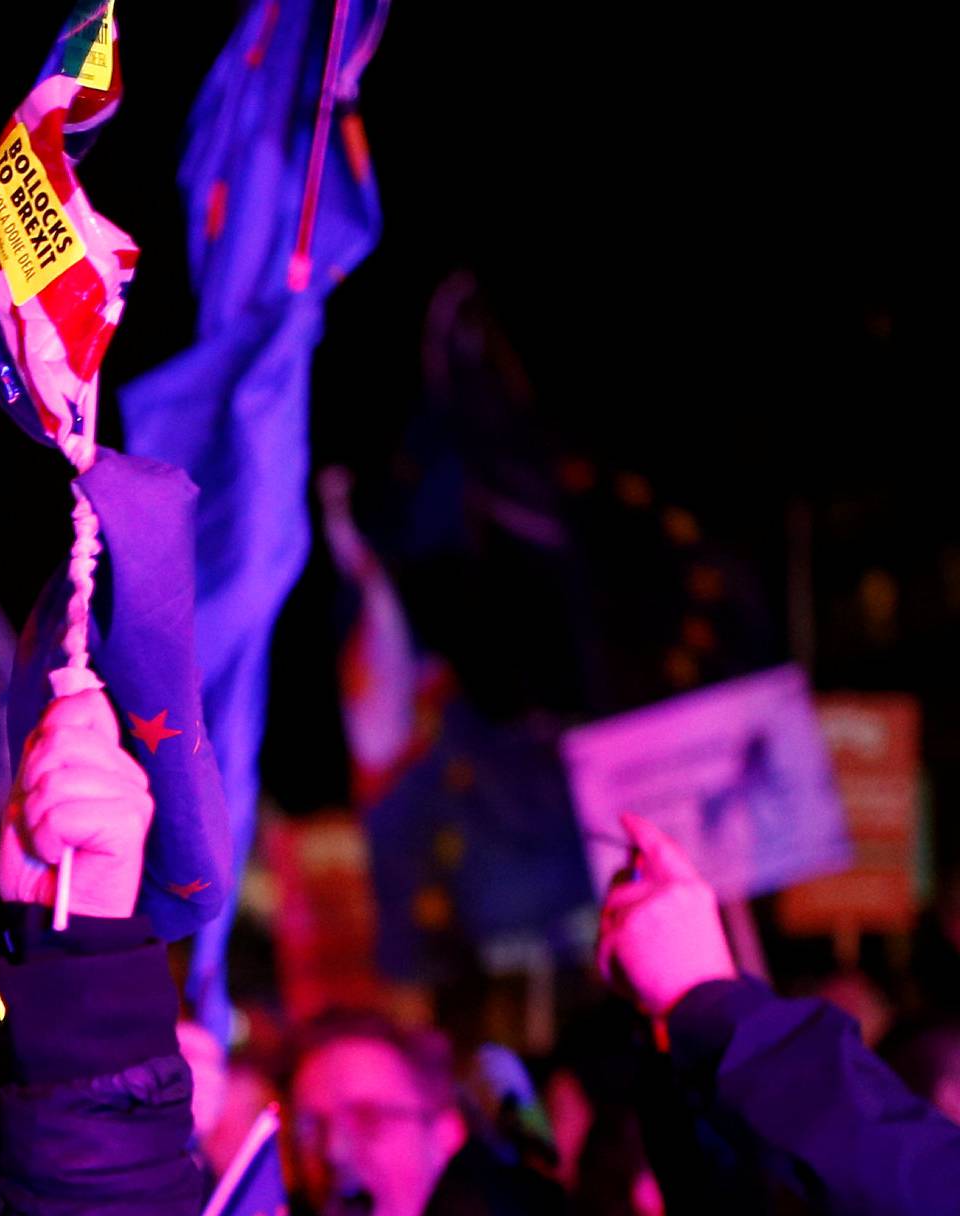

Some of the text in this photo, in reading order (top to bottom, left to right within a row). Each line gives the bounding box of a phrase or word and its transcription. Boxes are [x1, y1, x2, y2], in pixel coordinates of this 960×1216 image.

[9, 137, 73, 253] BOLLOCKS
[10, 186, 56, 269] BREXIT
[4, 223, 25, 254] DONE
[18, 253, 36, 281] DEAL
